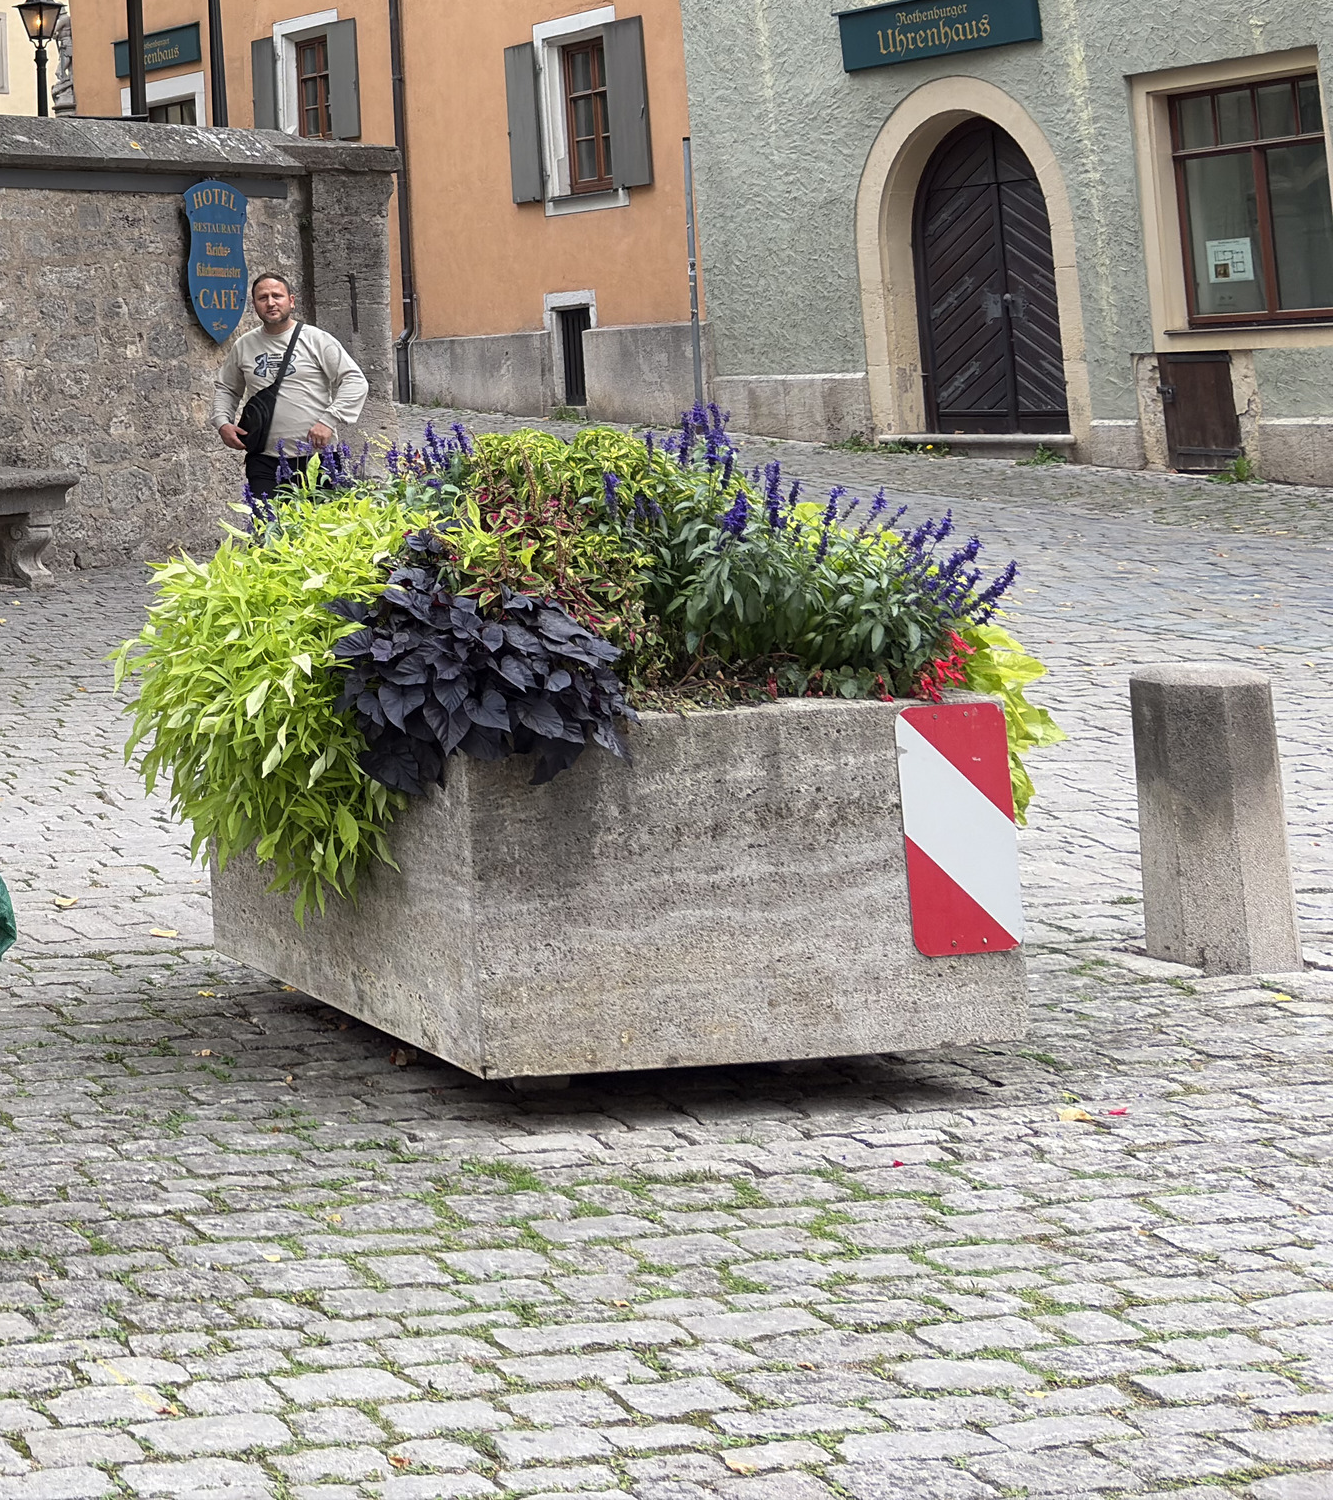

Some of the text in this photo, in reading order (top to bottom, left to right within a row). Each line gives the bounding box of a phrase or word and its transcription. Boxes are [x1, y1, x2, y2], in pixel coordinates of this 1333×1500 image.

[895, 3, 968, 26] Rothenburger
[876, 14, 991, 57] Uhrenhaus
[193, 188, 237, 211] HOTEL
[193, 221, 241, 234] RESTAURANT
[199, 283, 239, 311] CAFÉ
